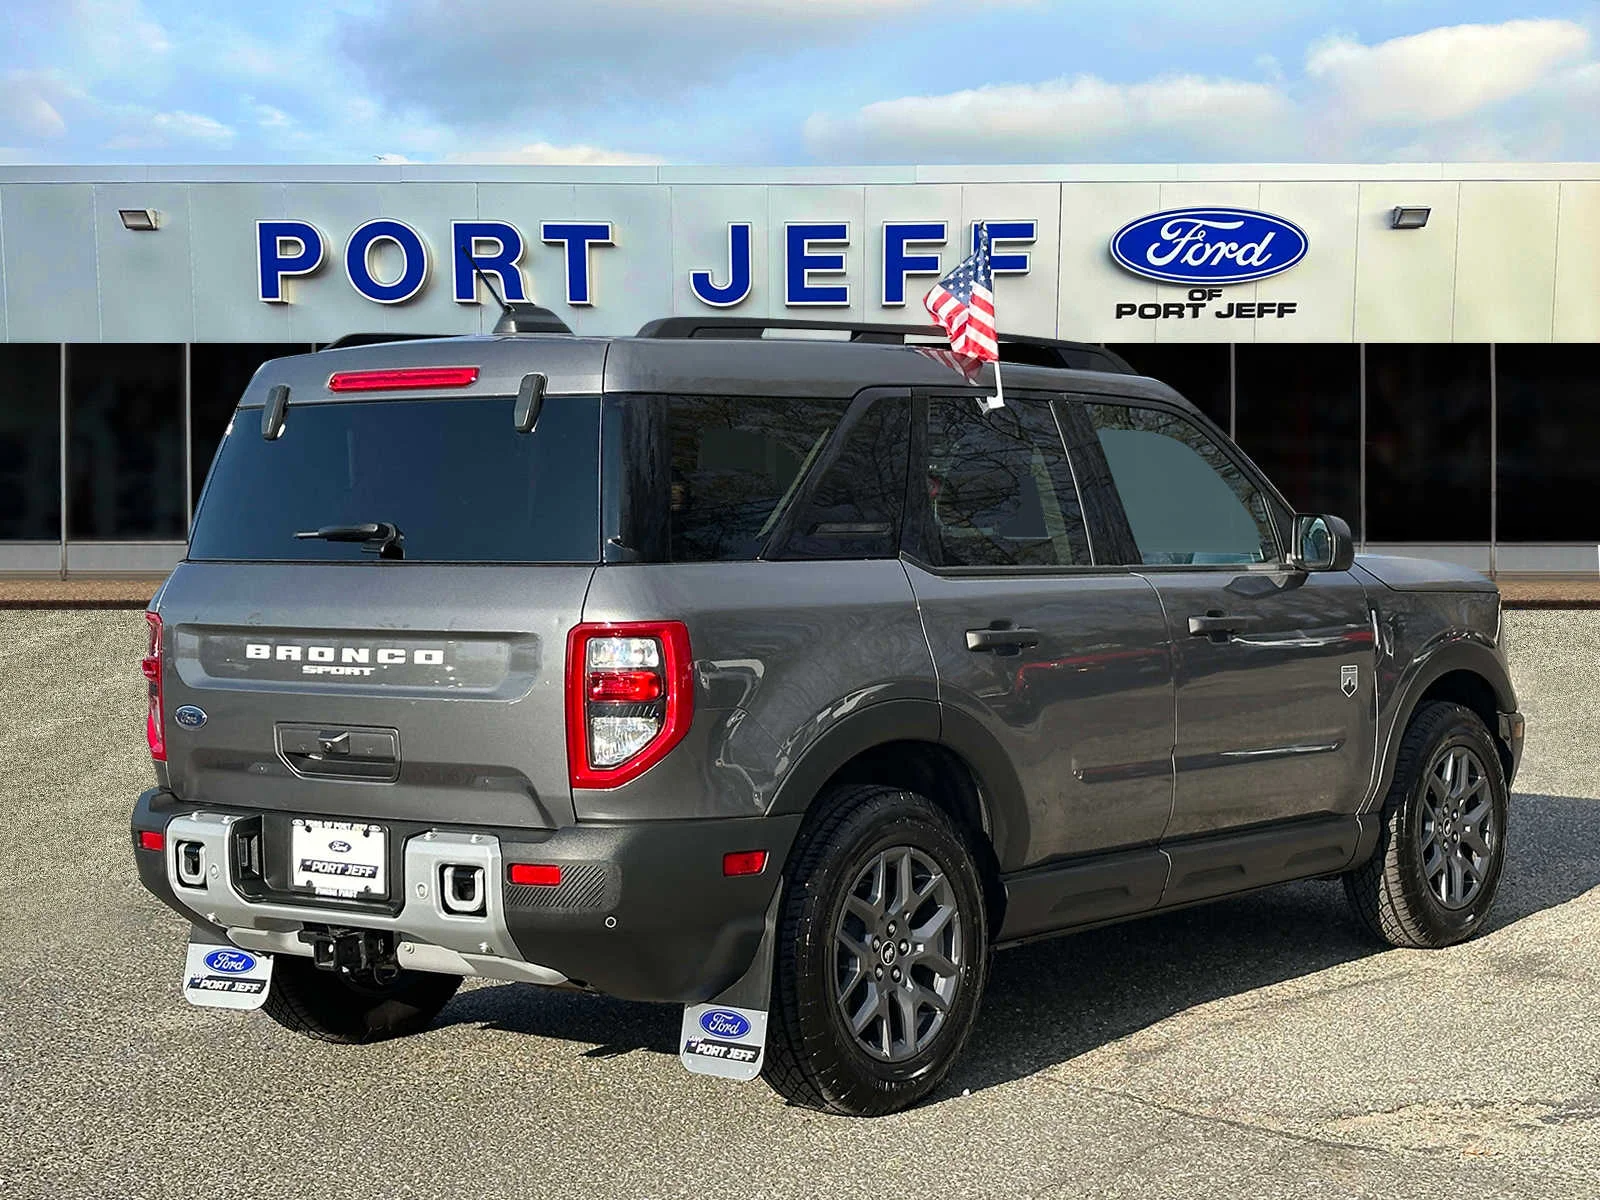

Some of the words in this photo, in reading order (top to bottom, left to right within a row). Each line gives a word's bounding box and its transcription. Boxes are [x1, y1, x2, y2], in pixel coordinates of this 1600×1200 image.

[1146, 217, 1276, 267] Ford
[255, 217, 616, 304] PORT
[689, 219, 1038, 307] JEFF
[1188, 288, 1223, 302] OF
[1115, 302, 1207, 319] PORT
[1214, 302, 1298, 319] JEFF
[245, 643, 444, 665] BRONCO
[302, 665, 376, 676] SPORT
[312, 862, 344, 874] PORT
[345, 865, 374, 876] JEFF
[213, 953, 246, 969] Ford
[200, 980, 231, 990] PORT
[231, 982, 260, 992] JEFF
[709, 1013, 739, 1034] Ford
[696, 1043, 727, 1056] PORT
[727, 1047, 755, 1060] JEFF
